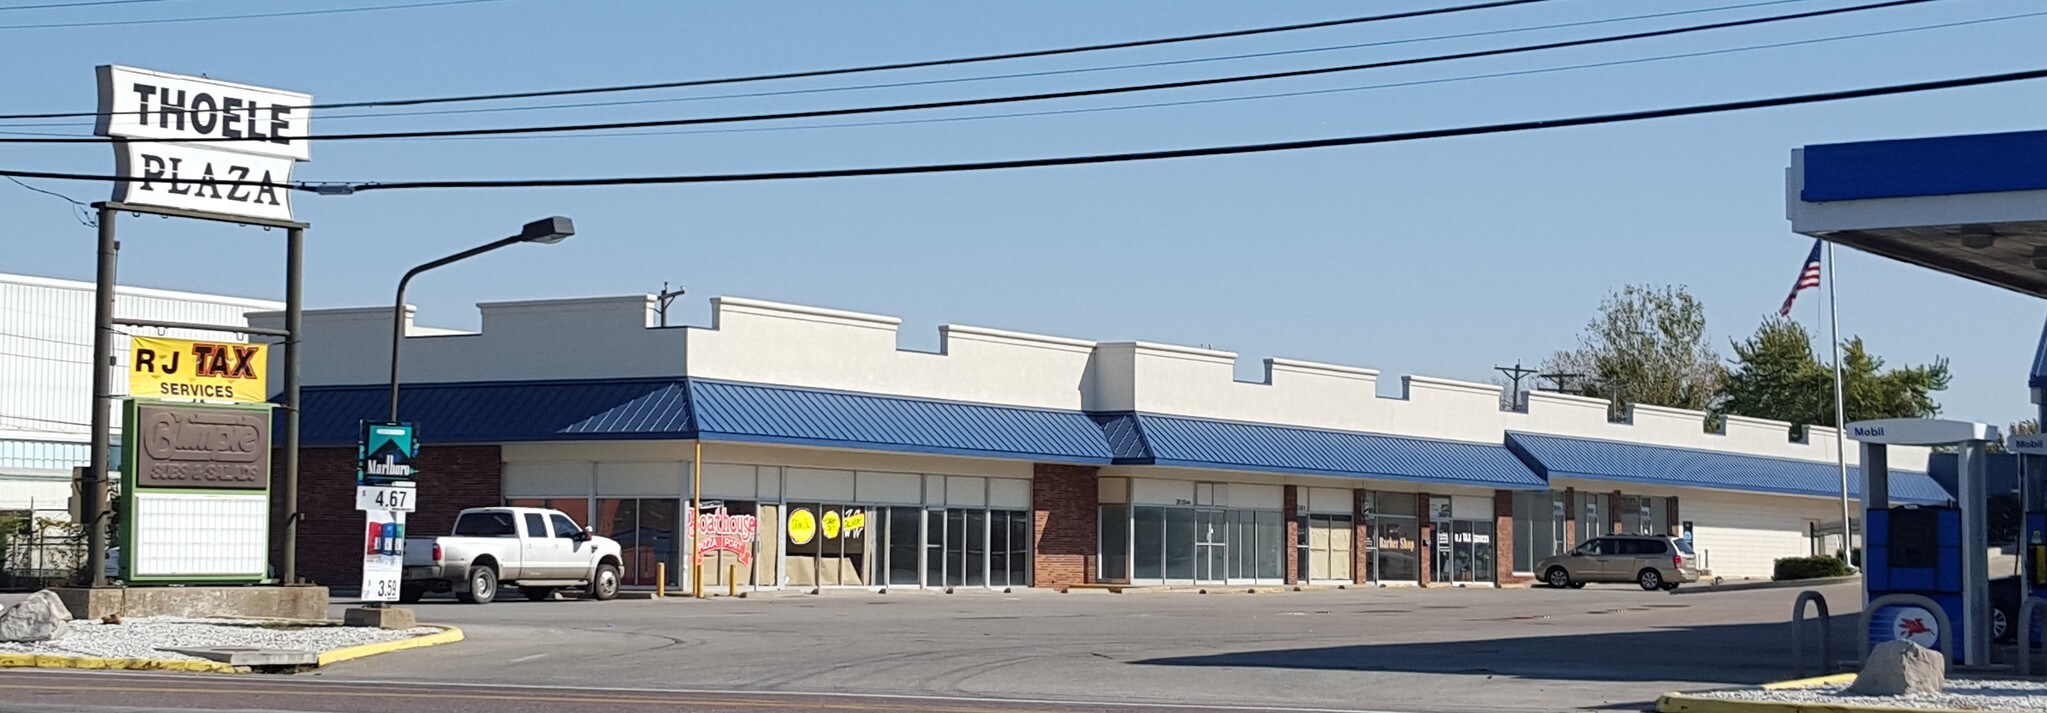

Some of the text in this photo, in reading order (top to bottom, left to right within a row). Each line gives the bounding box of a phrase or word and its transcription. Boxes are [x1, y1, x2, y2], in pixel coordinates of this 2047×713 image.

[133, 83, 291, 145] THOELE
[139, 154, 281, 206] PLAZA
[192, 343, 259, 380] TAX
[160, 382, 234, 398] SERVICES
[1854, 427, 1885, 437] Mobil
[2015, 440, 2044, 449] Mobil
[151, 462, 188, 480] SUBS
[367, 454, 410, 476] Marlboro
[375, 490, 407, 508] 4.67
[1379, 536, 1399, 549] Barber
[1399, 536, 1415, 552] Shop
[377, 580, 397, 597] 3.59
